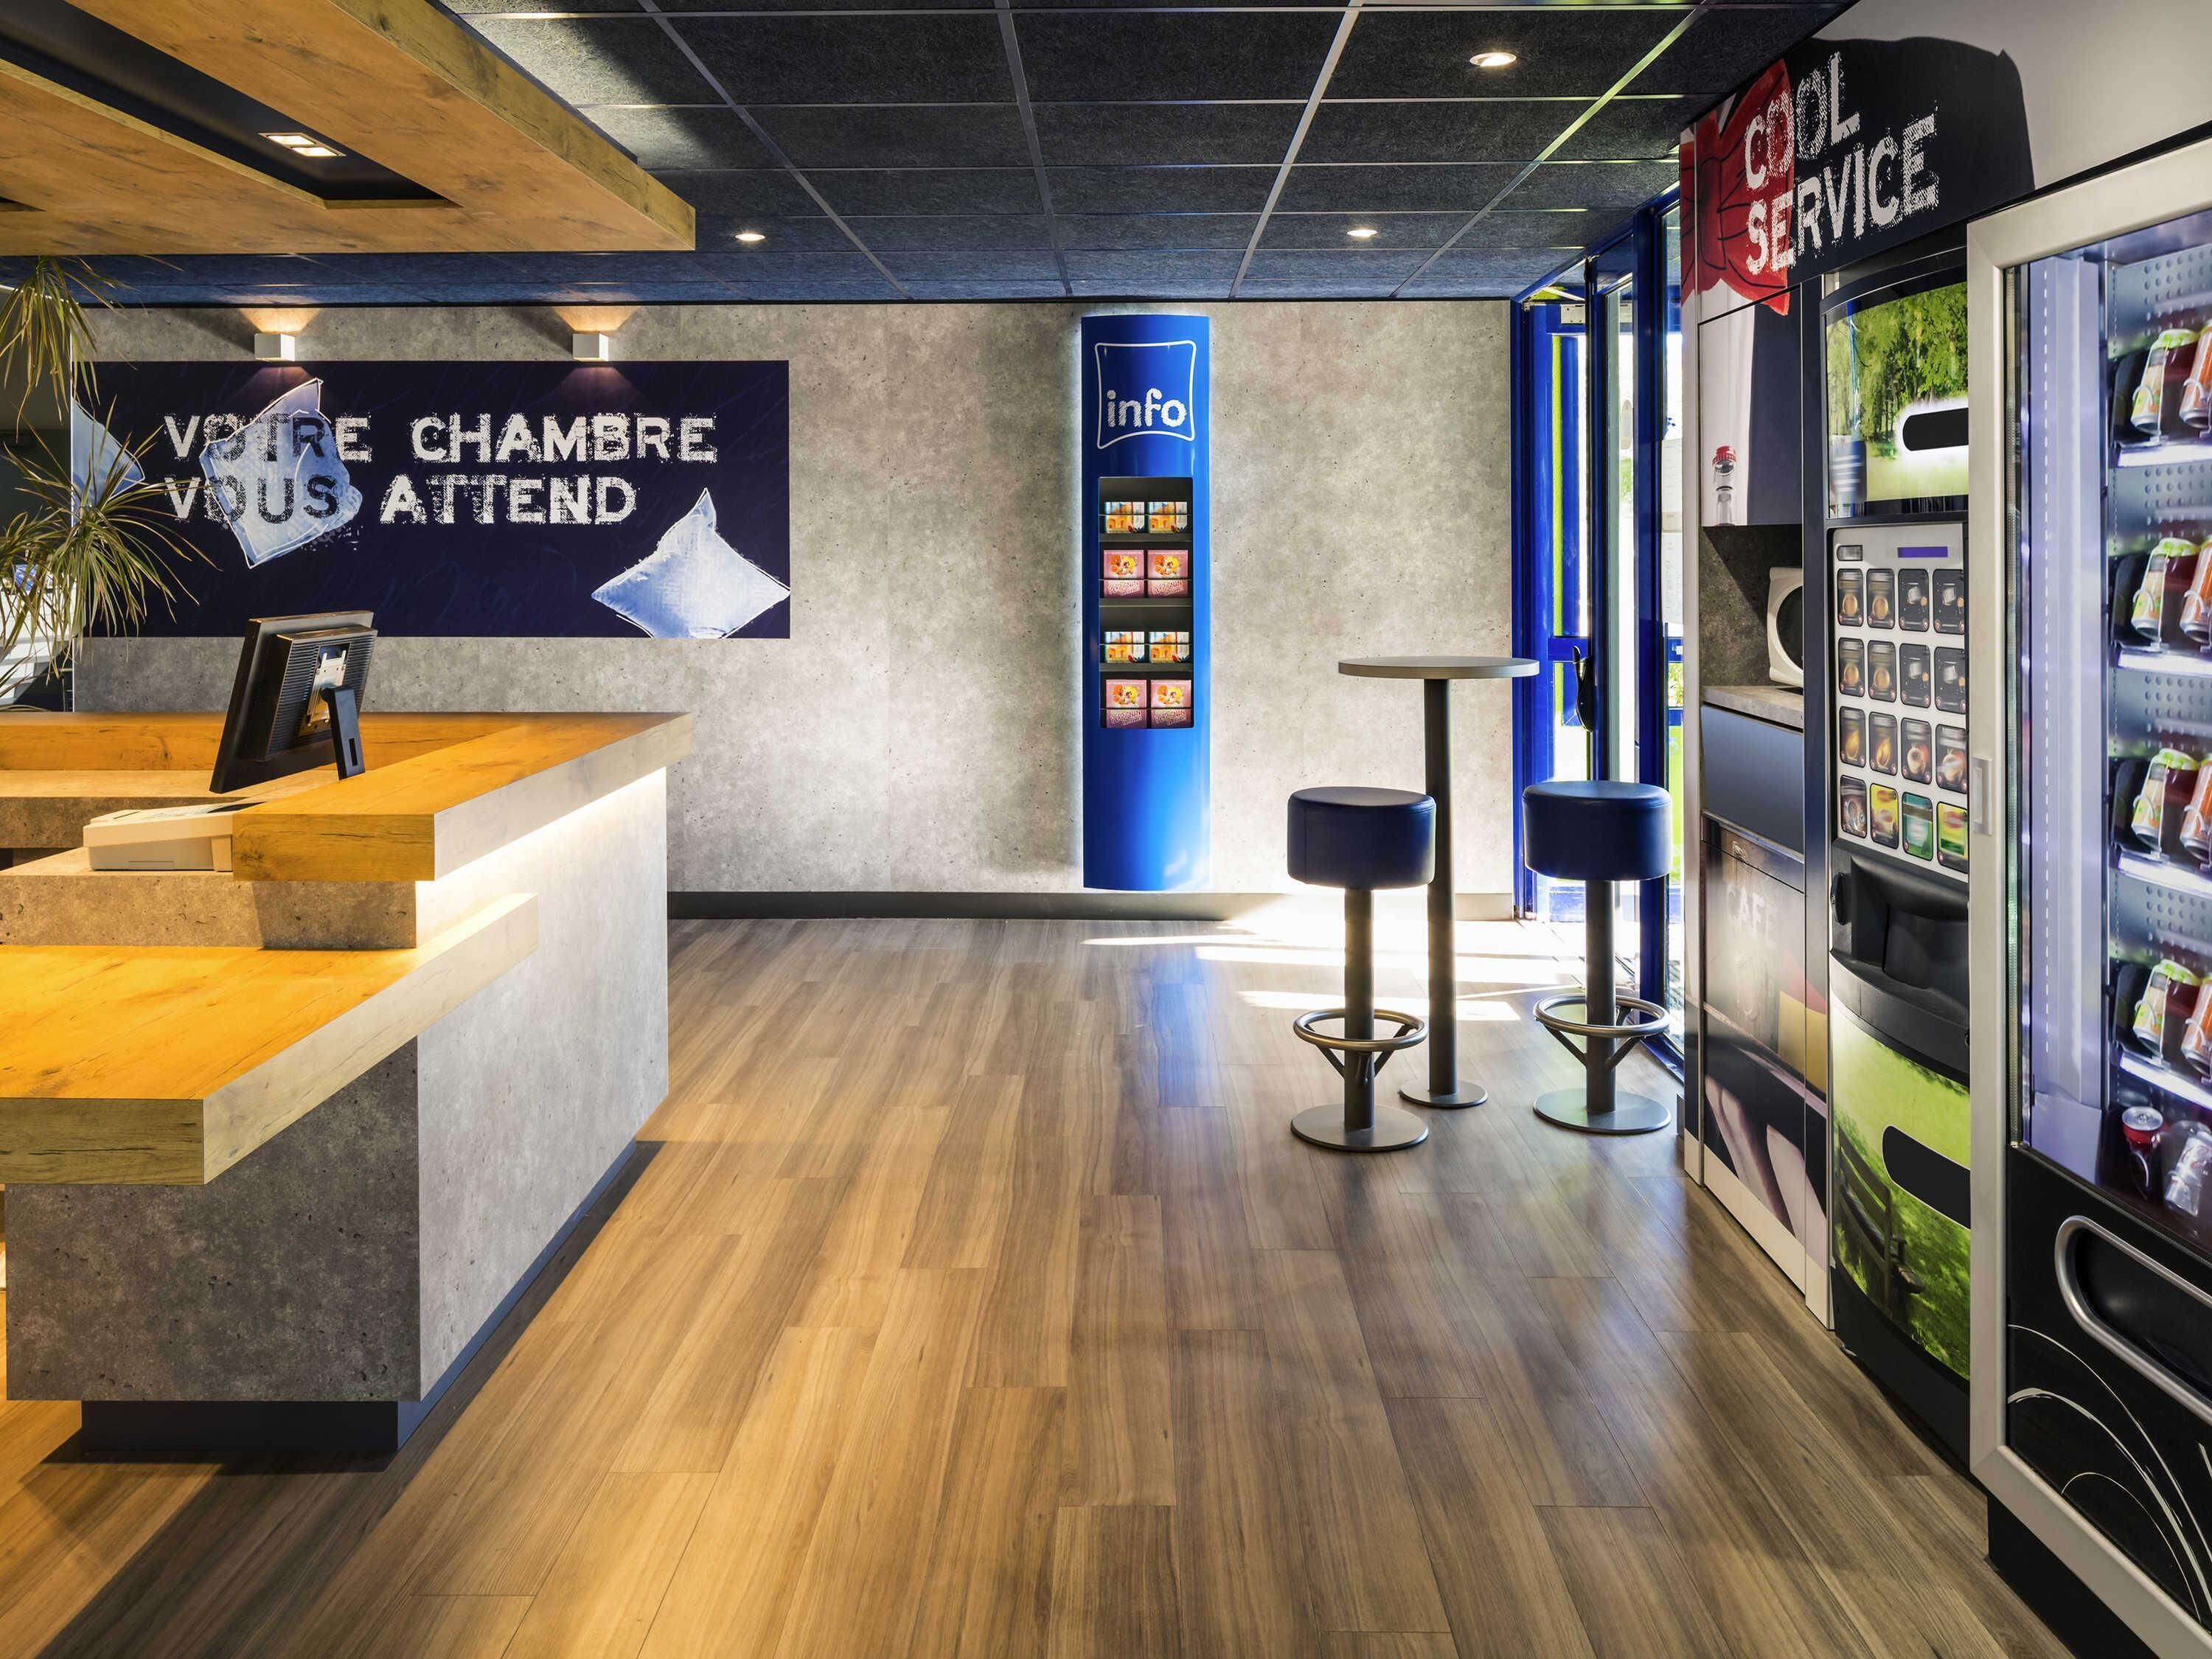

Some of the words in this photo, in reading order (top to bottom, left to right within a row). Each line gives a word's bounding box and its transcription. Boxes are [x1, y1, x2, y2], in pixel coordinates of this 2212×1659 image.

[1745, 52, 1860, 191] COOL
[1745, 112, 1940, 276] SERVICE
[1107, 388, 1187, 427] info
[163, 413, 372, 462] VOTRE
[411, 413, 718, 463] CHAMBRE
[163, 474, 341, 524] VOUS
[379, 474, 639, 525] ATTEND
